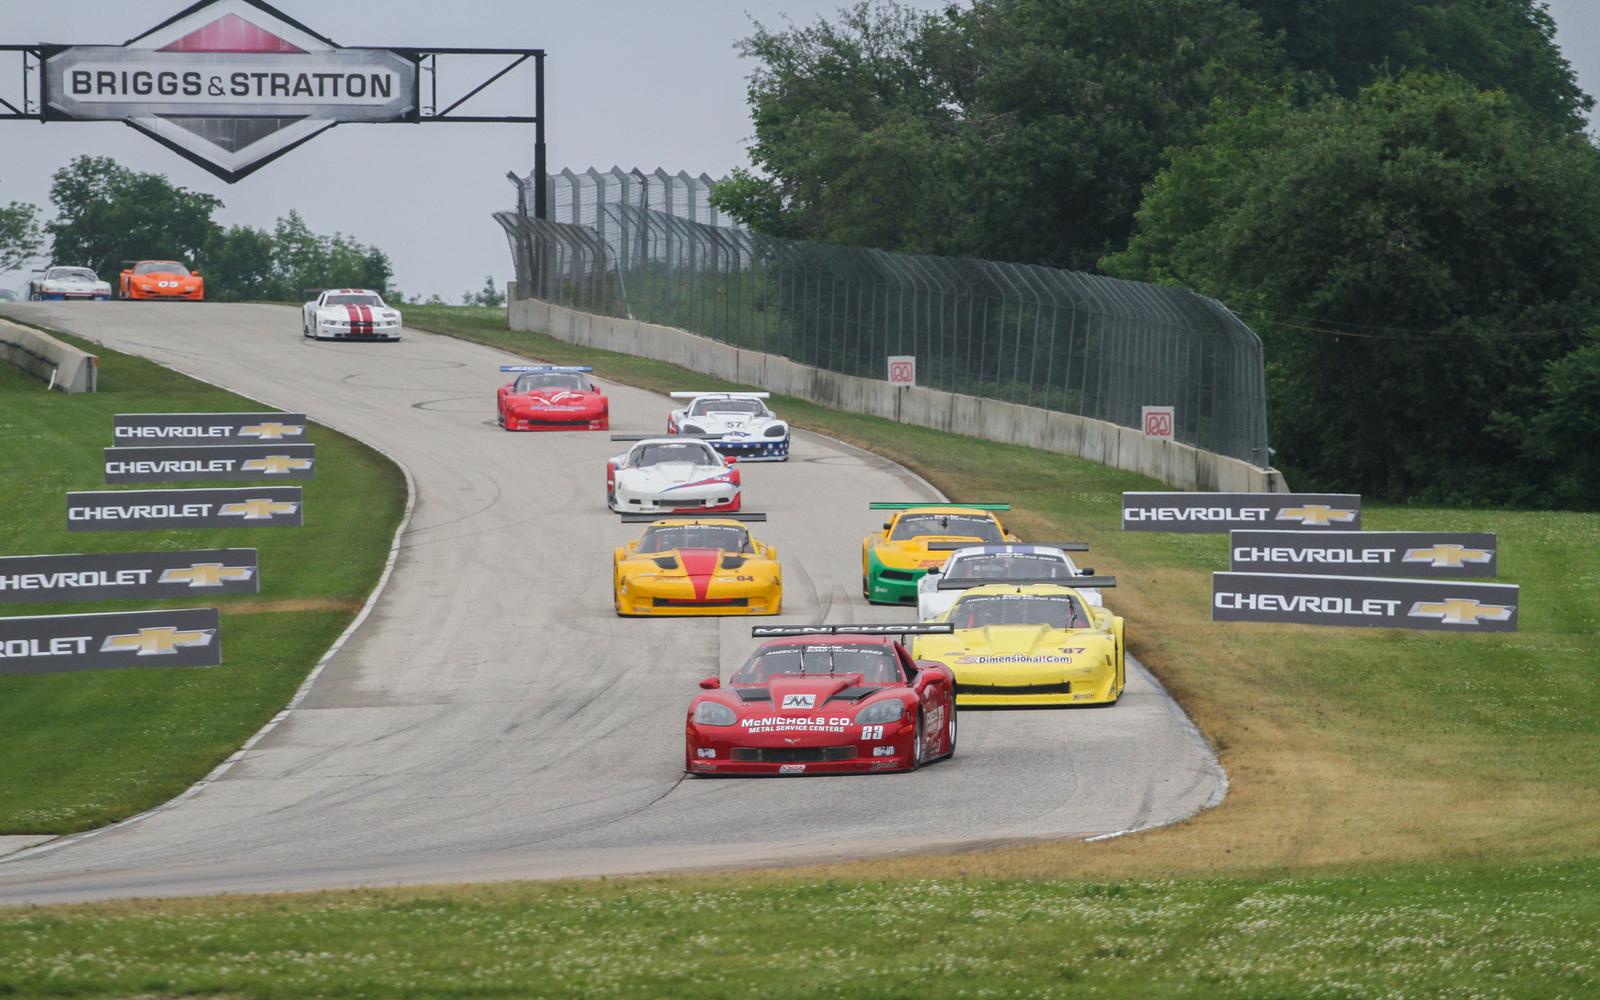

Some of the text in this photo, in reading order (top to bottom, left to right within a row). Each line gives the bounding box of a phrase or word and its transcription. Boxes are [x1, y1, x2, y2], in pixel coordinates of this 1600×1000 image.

[115, 426, 234, 437] CHEVROLET
[106, 460, 236, 474] CHEVROLET
[69, 504, 213, 520] CHEVROLET
[1124, 507, 1270, 521] CHEVROLET
[1234, 547, 1396, 563] CHEVROLET
[1215, 592, 1401, 616] CHEVROLET
[742, 717, 853, 727] McNICHOLS CO.
[861, 726, 884, 740] 23
